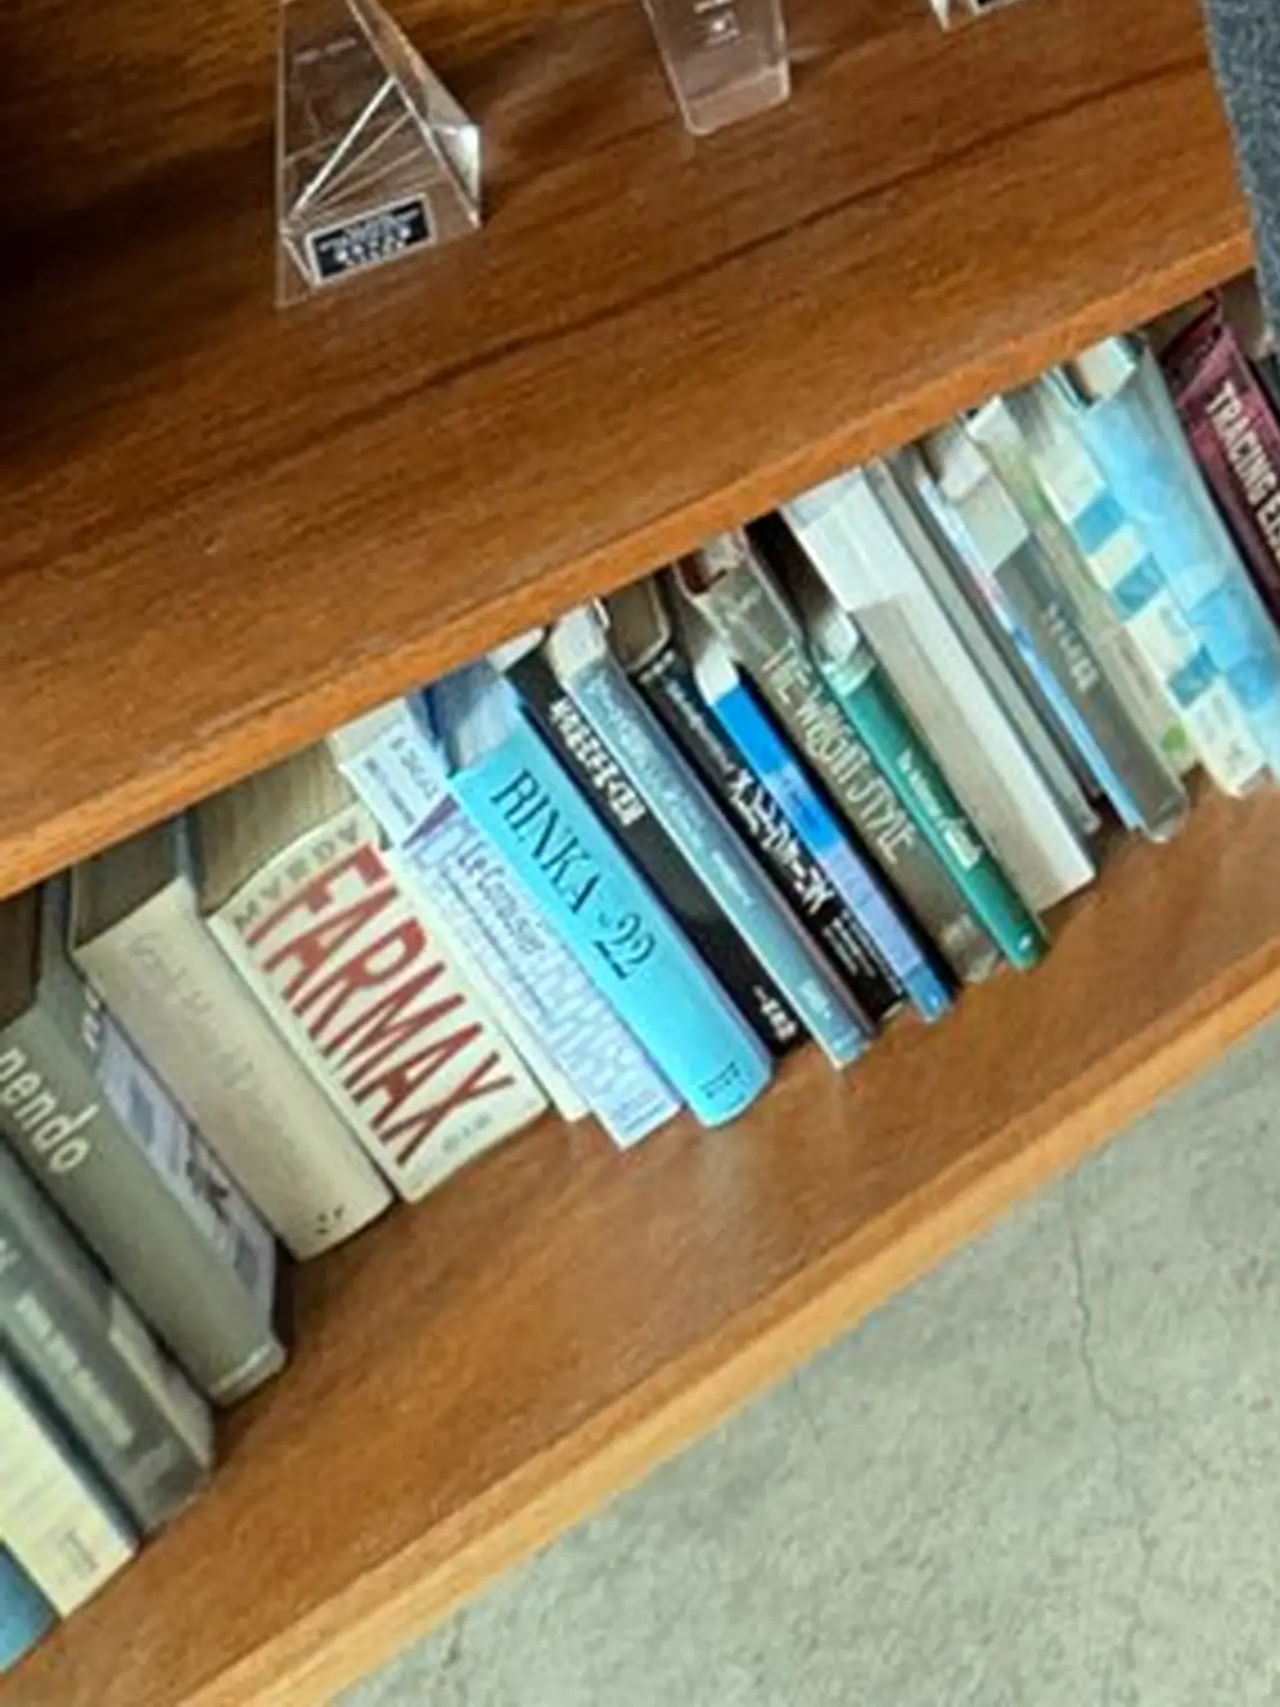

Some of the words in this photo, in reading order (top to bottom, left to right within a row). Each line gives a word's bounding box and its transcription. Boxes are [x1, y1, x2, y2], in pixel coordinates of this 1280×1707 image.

[1205, 380, 1278, 507] TRACING
[245, 843, 517, 1168] FARMAX
[0, 1044, 99, 1175] nendo
